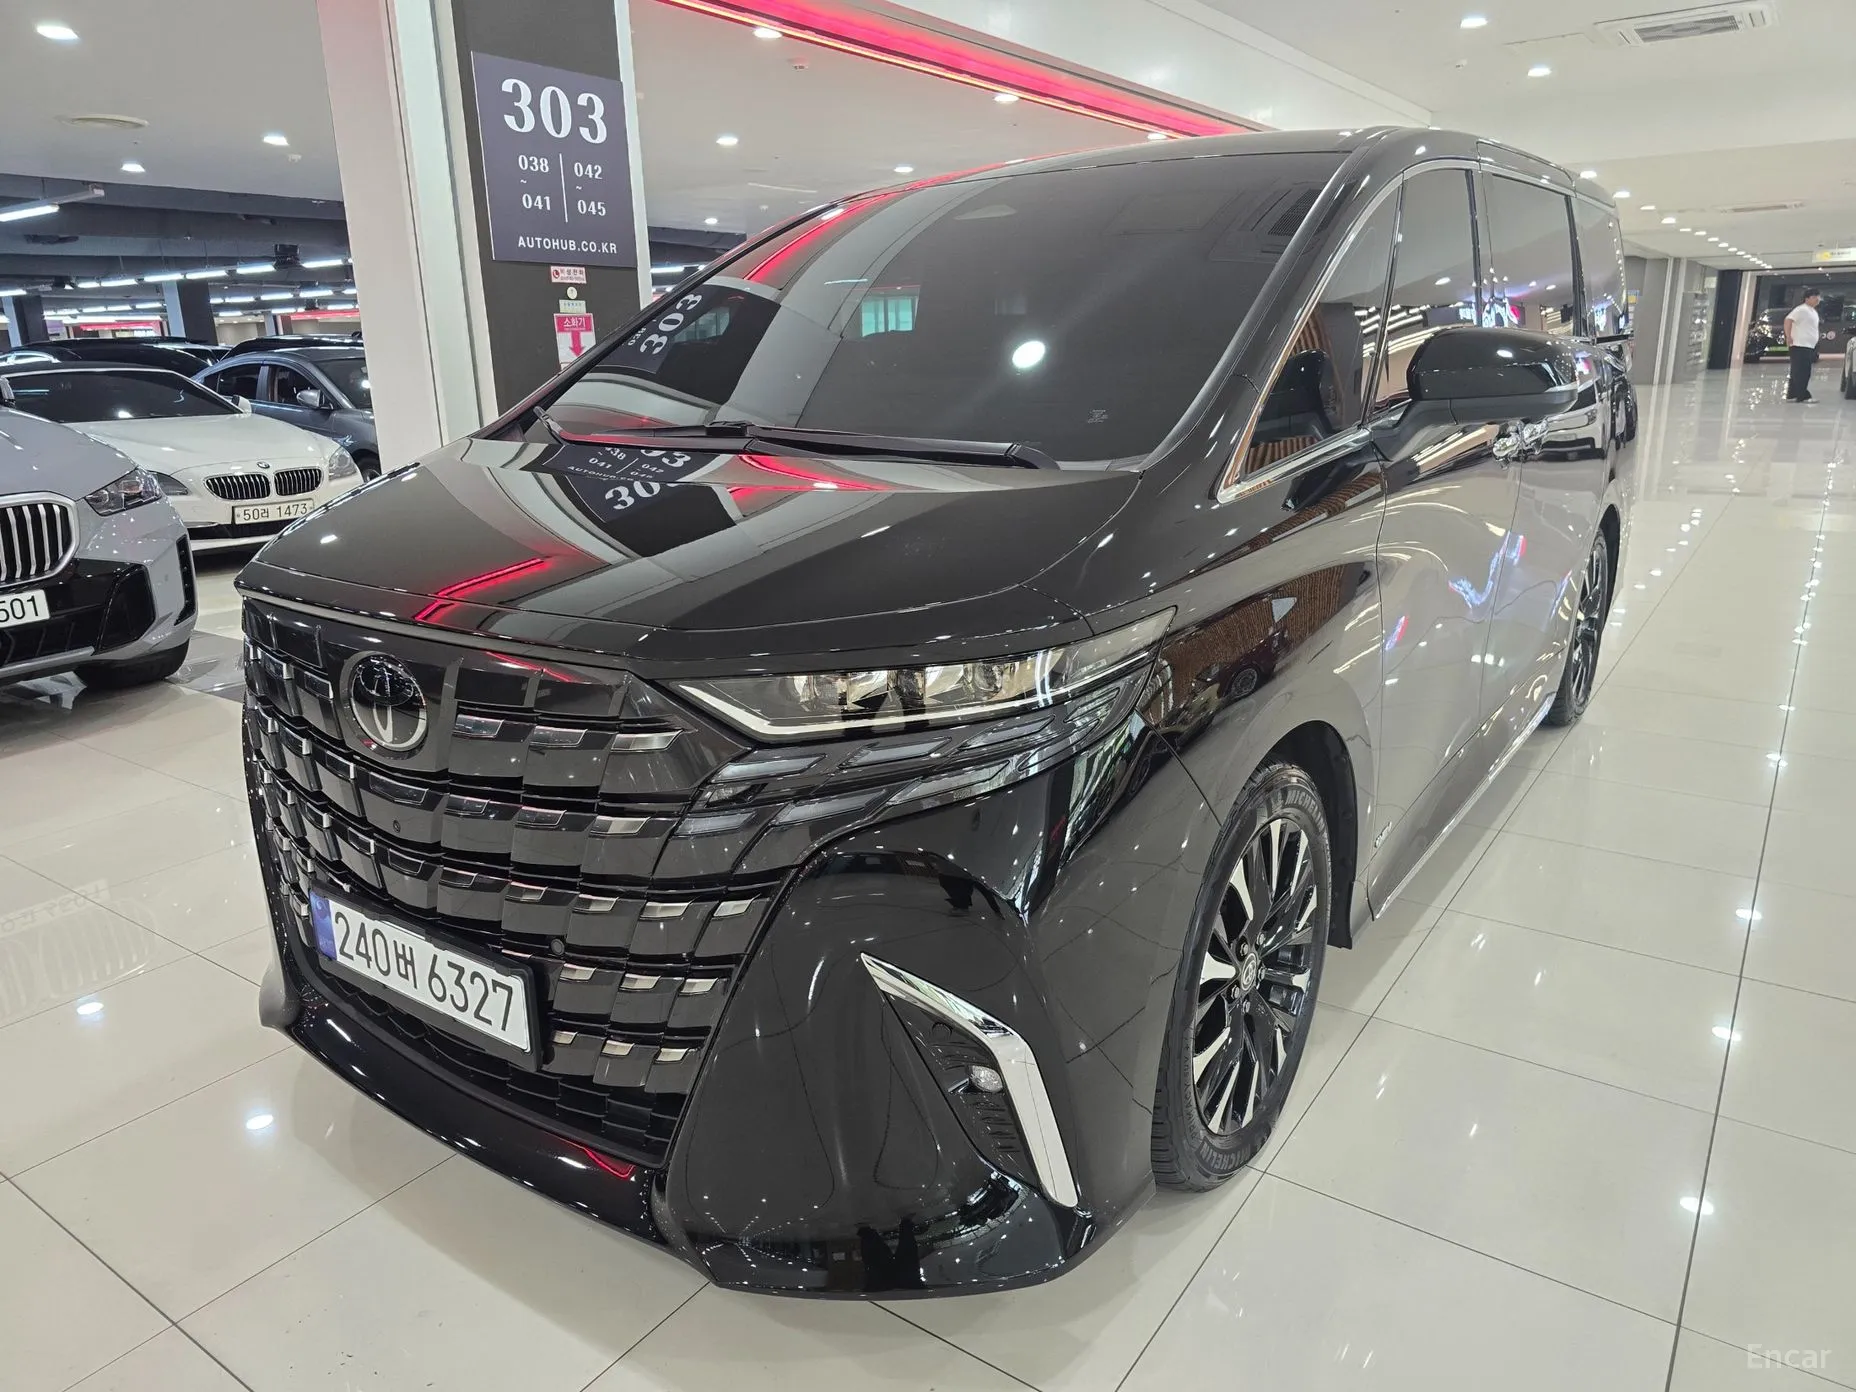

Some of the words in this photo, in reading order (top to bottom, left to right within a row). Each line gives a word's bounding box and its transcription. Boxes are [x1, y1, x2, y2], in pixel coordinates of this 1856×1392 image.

[501, 78, 607, 144] 303
[518, 155, 549, 173] 038
[574, 162, 603, 180] 042
[522, 193, 551, 211] 041
[577, 199, 606, 217] 045
[518, 235, 617, 254] AUTOHUB.CO.KR
[563, 317, 586, 327] 소화기
[243, 508, 269, 521] 50러
[276, 503, 308, 518] 1473
[334, 911, 418, 989] 240버
[428, 954, 513, 1032] 6327
